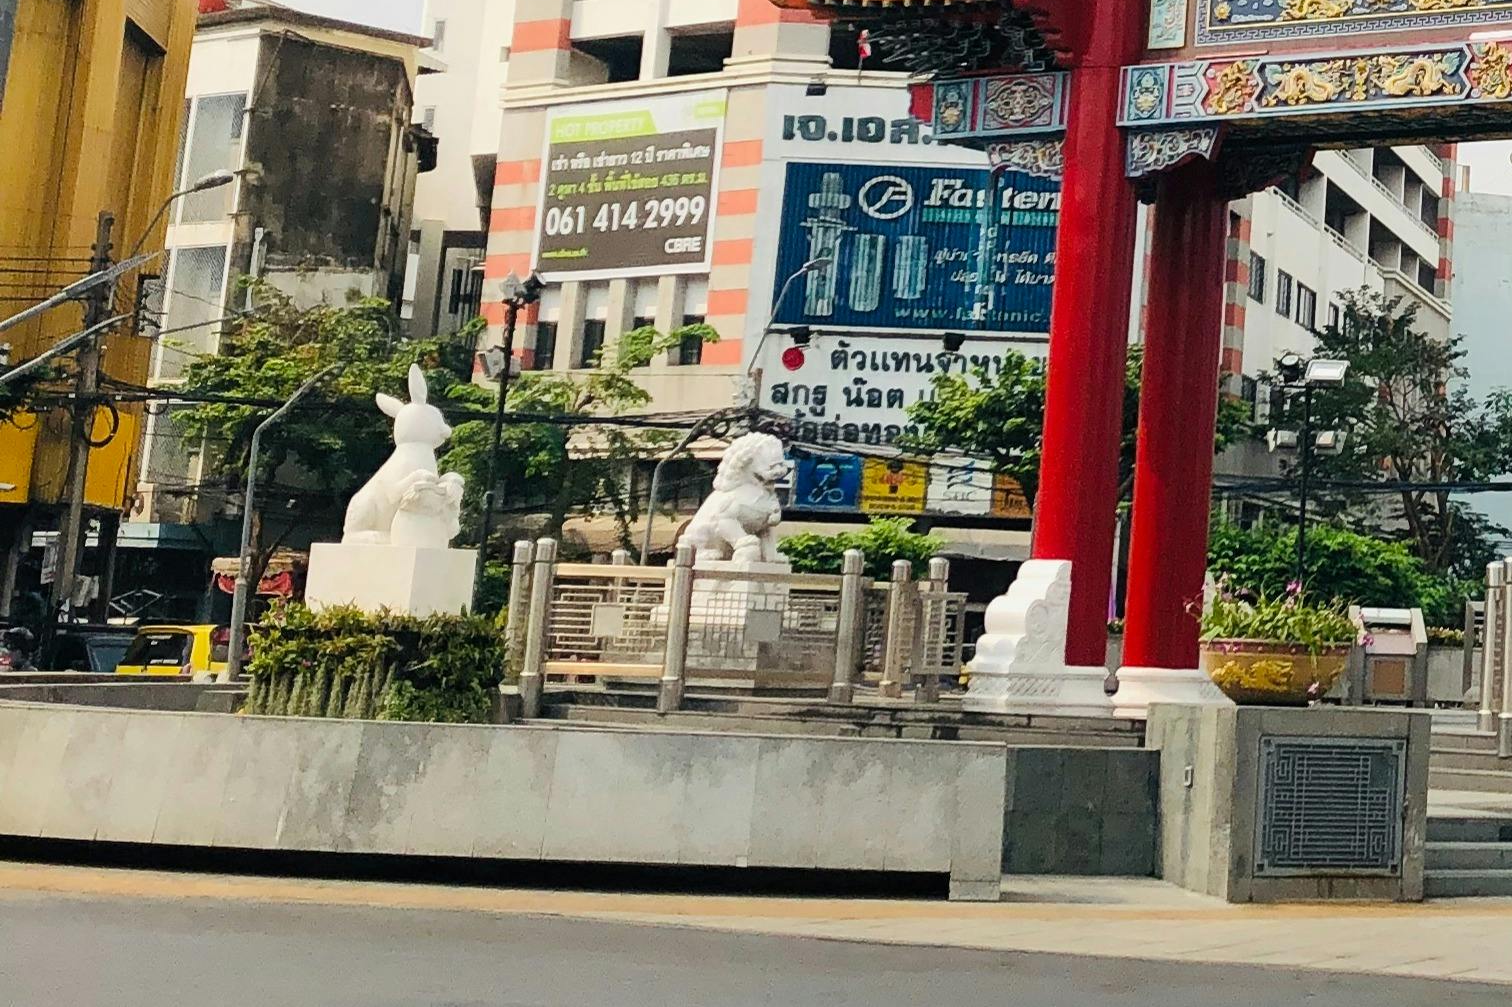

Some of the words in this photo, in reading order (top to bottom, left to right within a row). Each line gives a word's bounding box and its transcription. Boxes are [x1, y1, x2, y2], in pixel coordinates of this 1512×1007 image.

[545, 205, 586, 236] 061
[592, 201, 639, 233] 414
[643, 195, 705, 229] 2999
[770, 381, 828, 417] สกรู
